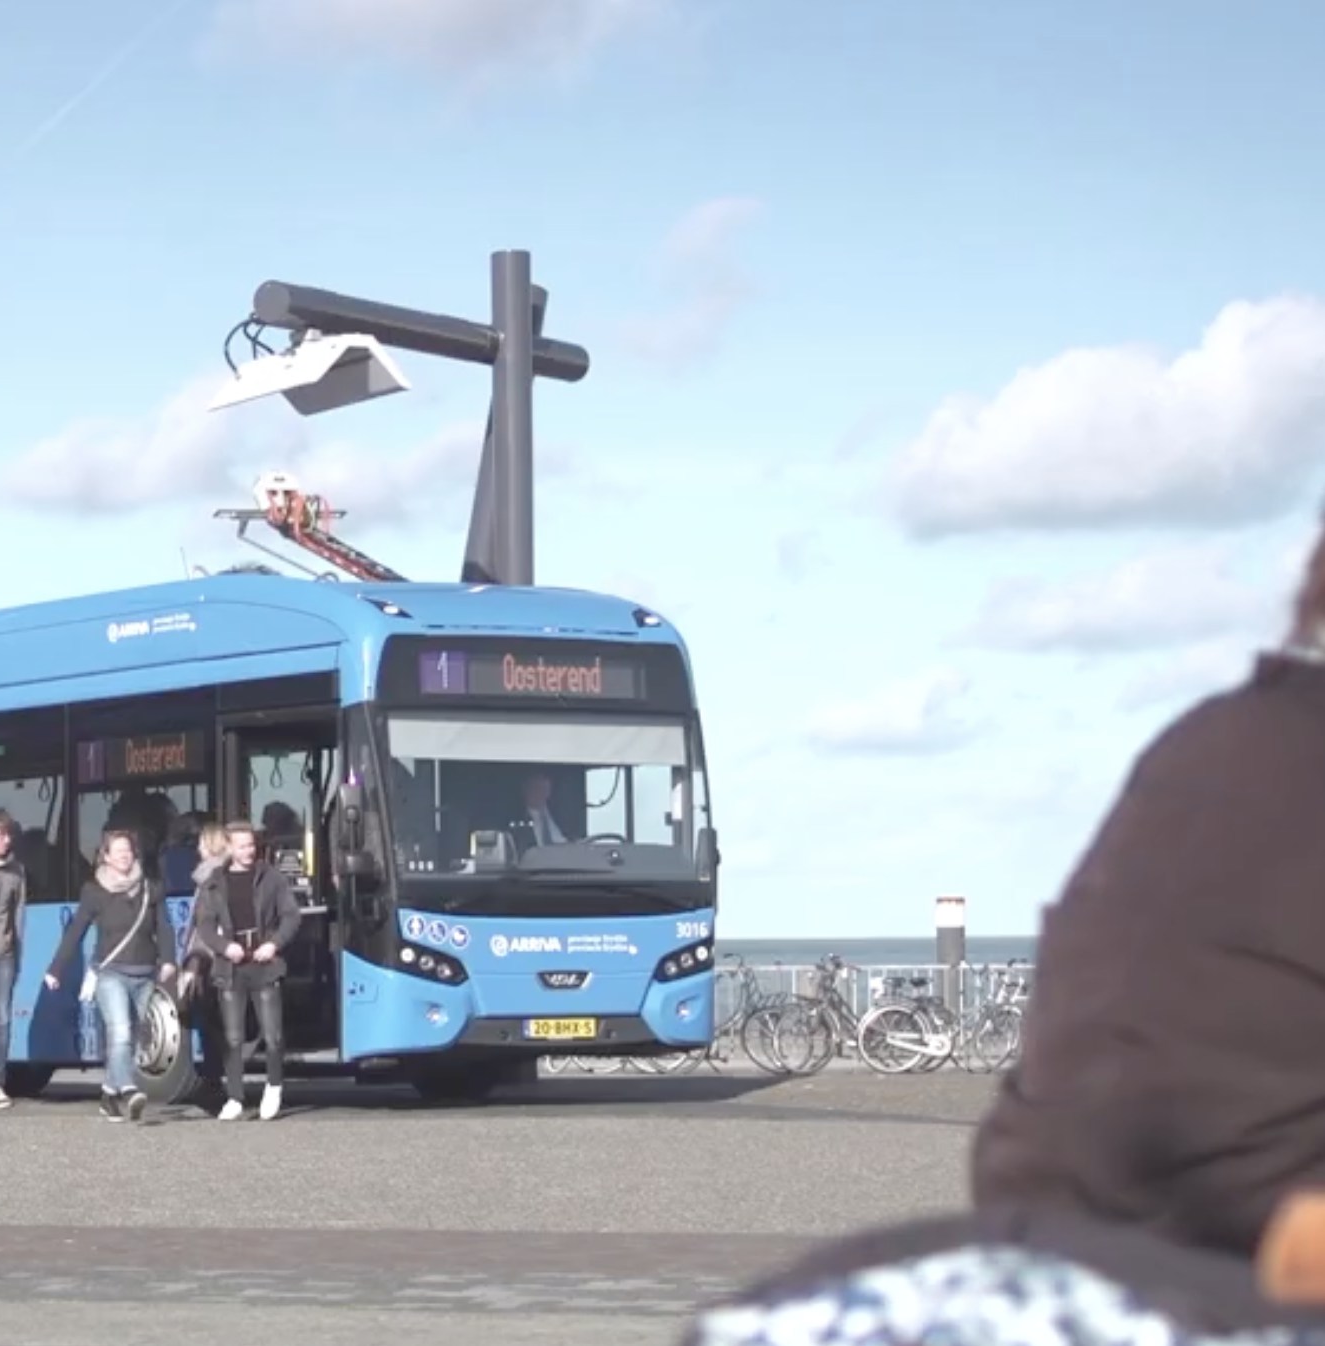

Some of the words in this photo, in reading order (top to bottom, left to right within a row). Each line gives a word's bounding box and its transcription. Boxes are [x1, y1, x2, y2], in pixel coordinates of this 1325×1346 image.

[436, 651, 449, 689] 1
[502, 653, 603, 694] Oosterend
[125, 732, 187, 775] Oosterend
[509, 936, 562, 952] ARRIVA
[675, 921, 709, 939] 3016
